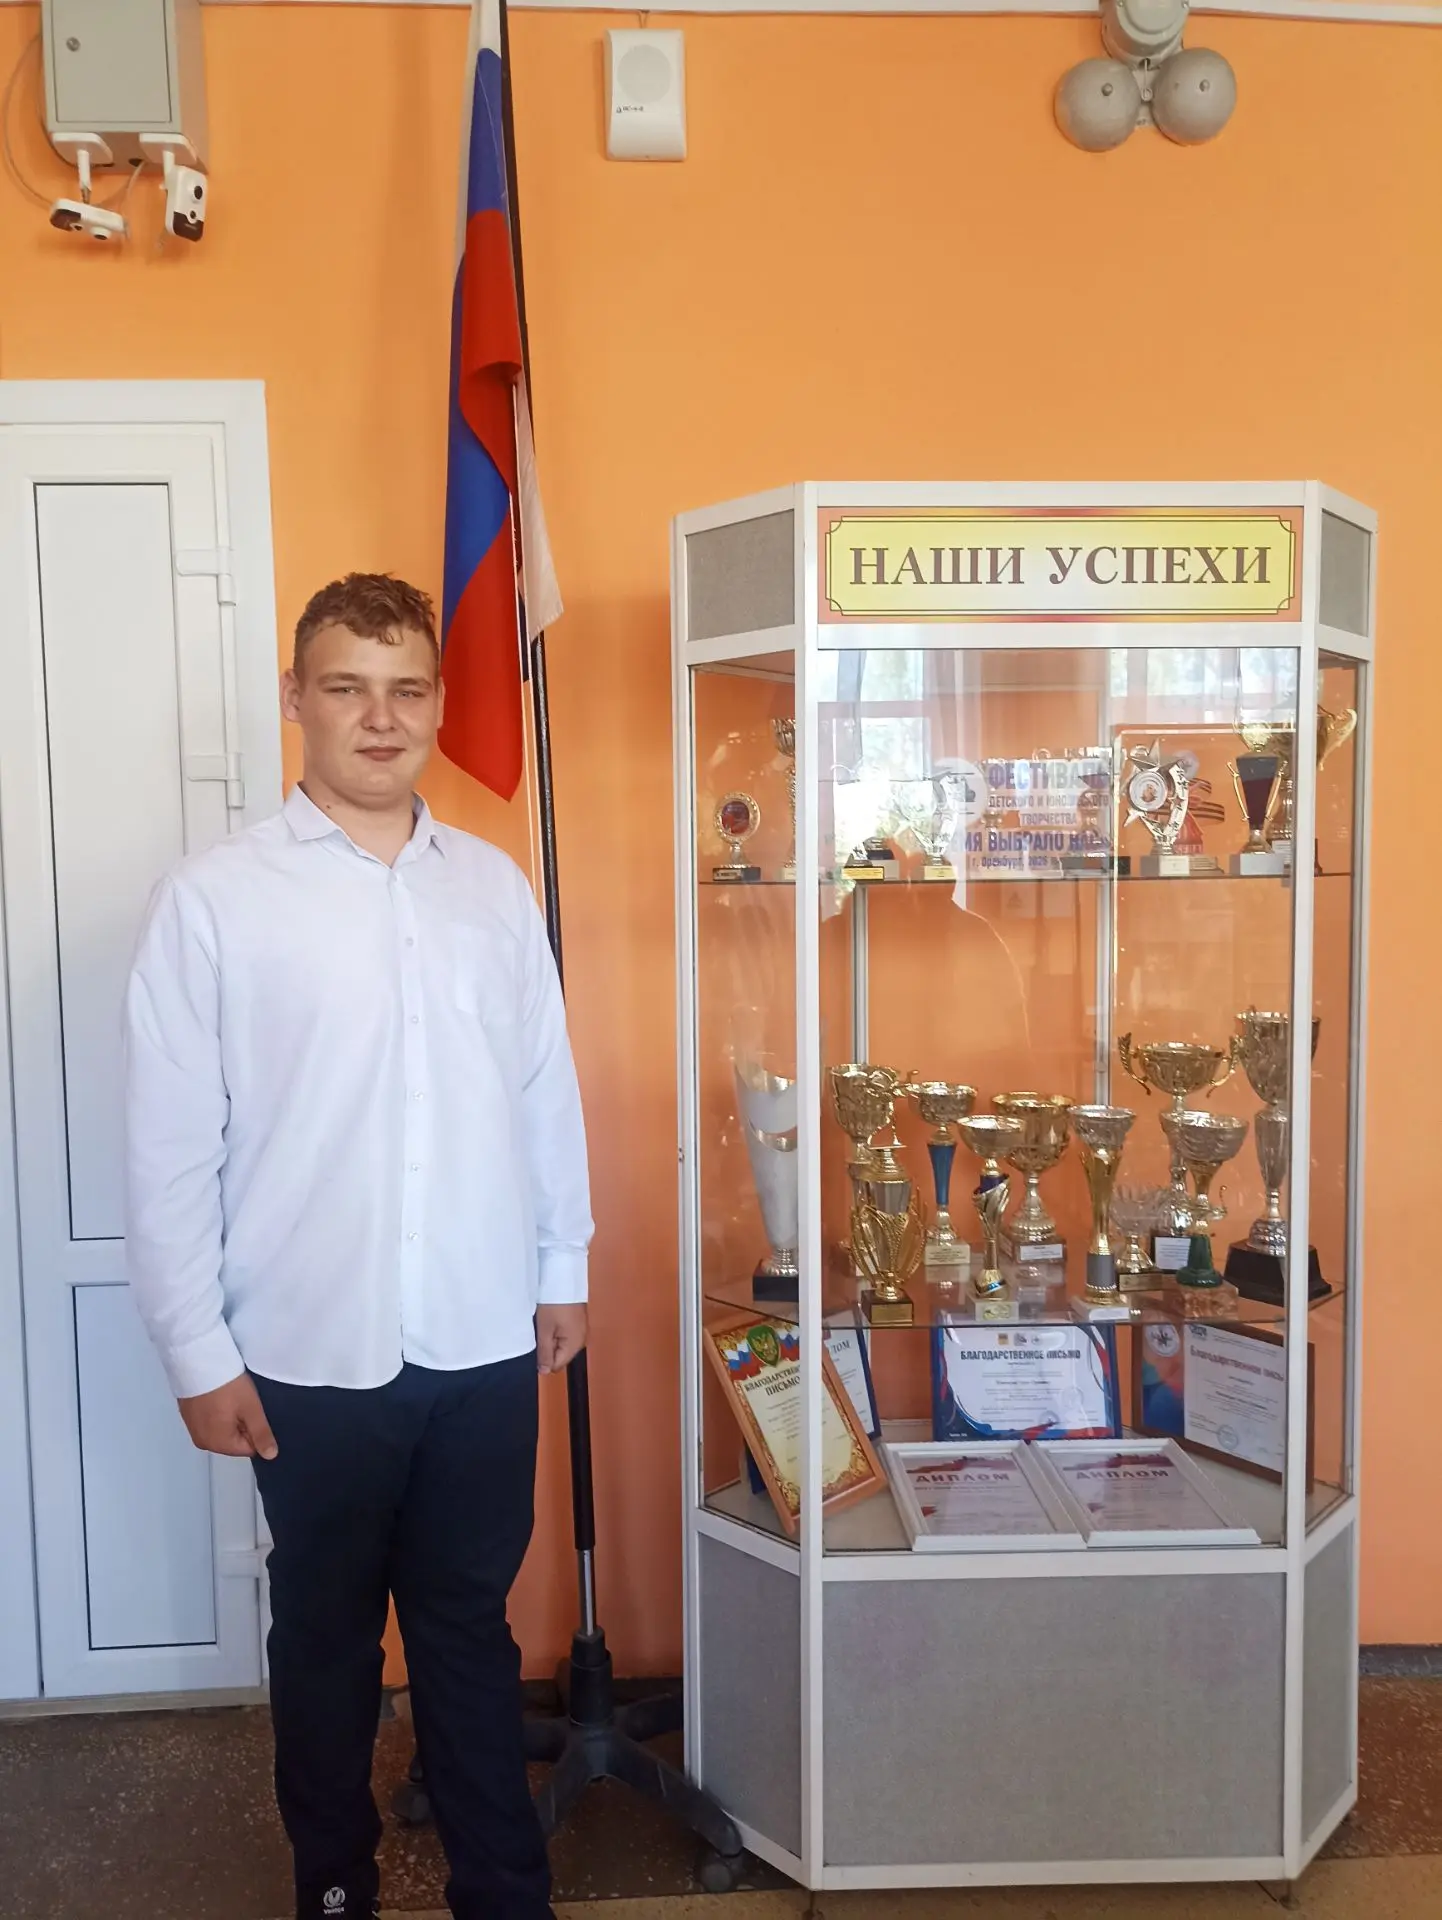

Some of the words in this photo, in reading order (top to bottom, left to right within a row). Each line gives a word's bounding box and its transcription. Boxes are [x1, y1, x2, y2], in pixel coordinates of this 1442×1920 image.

[849, 547, 1025, 585] НАШИ
[1046, 546, 1271, 585] УСПЕХИ
[916, 1472, 1011, 1483] ДИПЛОМ
[1076, 1468, 1169, 1481] ДИПЛОМ
